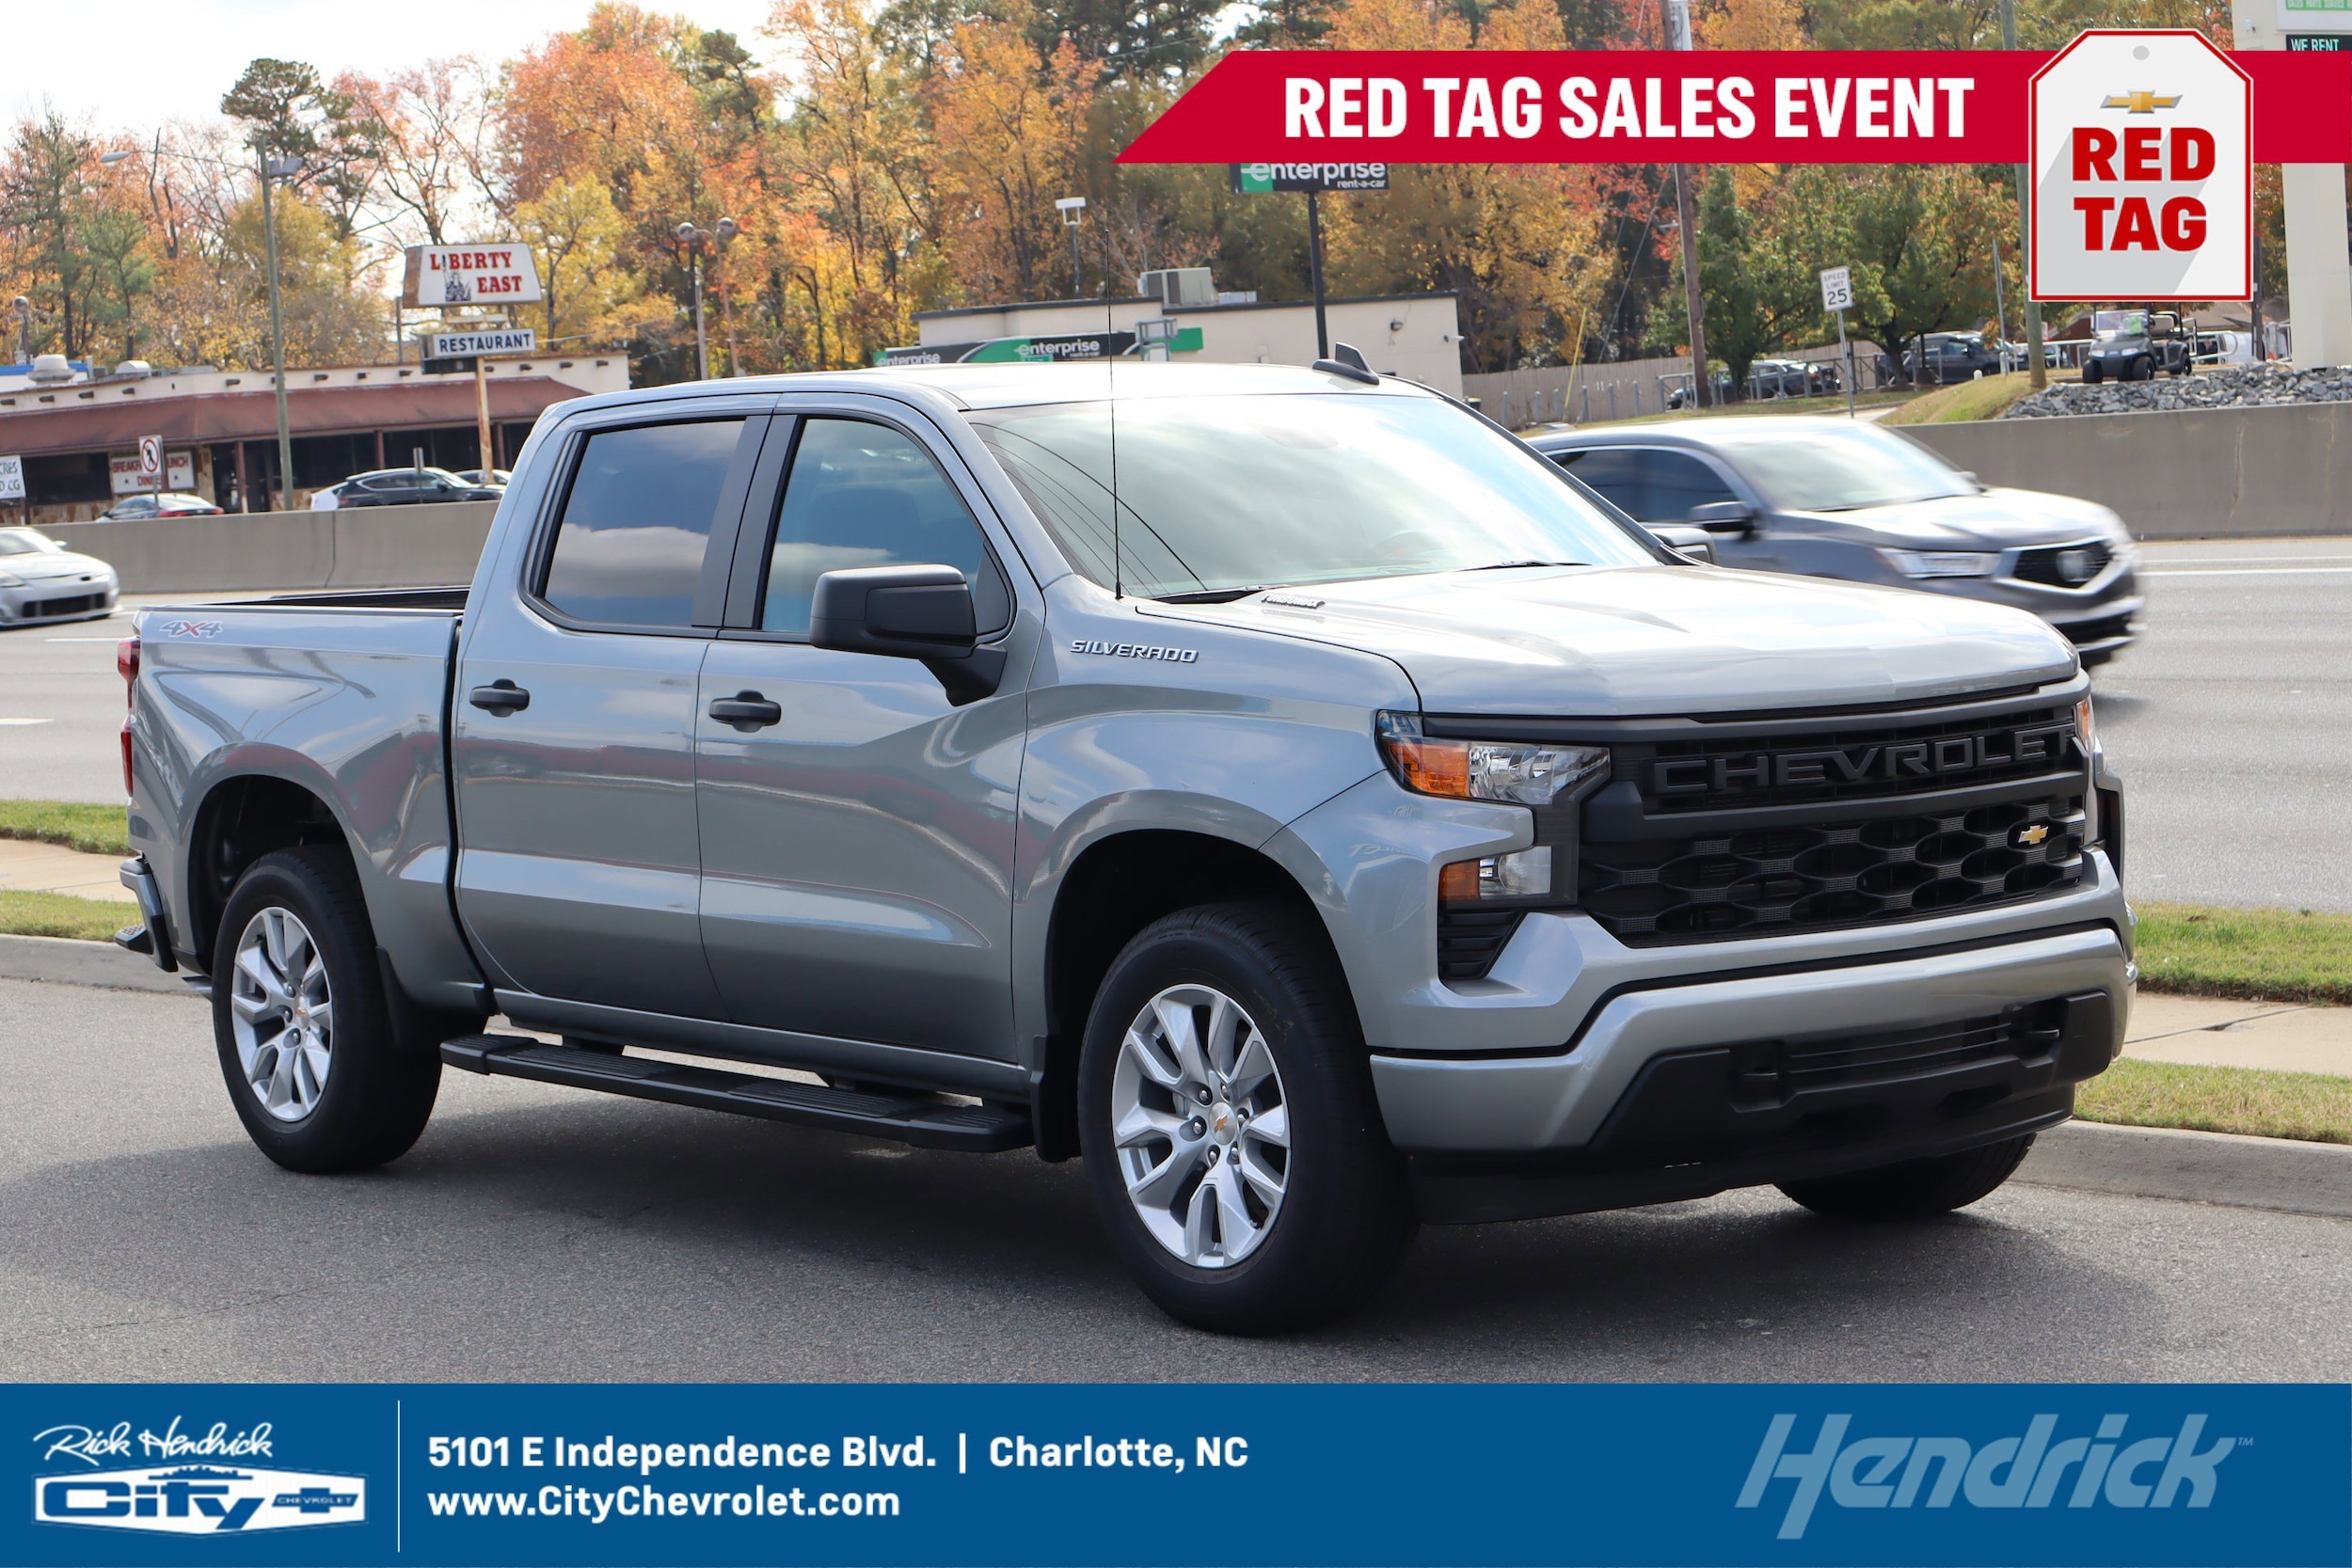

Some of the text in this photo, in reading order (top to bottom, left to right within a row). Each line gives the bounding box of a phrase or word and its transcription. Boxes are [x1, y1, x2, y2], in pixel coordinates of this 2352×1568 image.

[2291, 39, 2340, 51] WE RENT
[1242, 162, 1386, 185] enterprise
[1337, 180, 1386, 189] rent-a-car
[430, 251, 512, 271] LIBERTY
[477, 275, 523, 293] EAST
[1823, 271, 1846, 281] SPEED
[1826, 280, 1844, 290] LIMIT
[1827, 288, 1848, 306] 25
[439, 333, 532, 353] RESTAURANT
[1015, 339, 1100, 357] enterprise
[1070, 640, 1200, 664] SILVERADO
[1653, 722, 2075, 794] CHEVROLET
